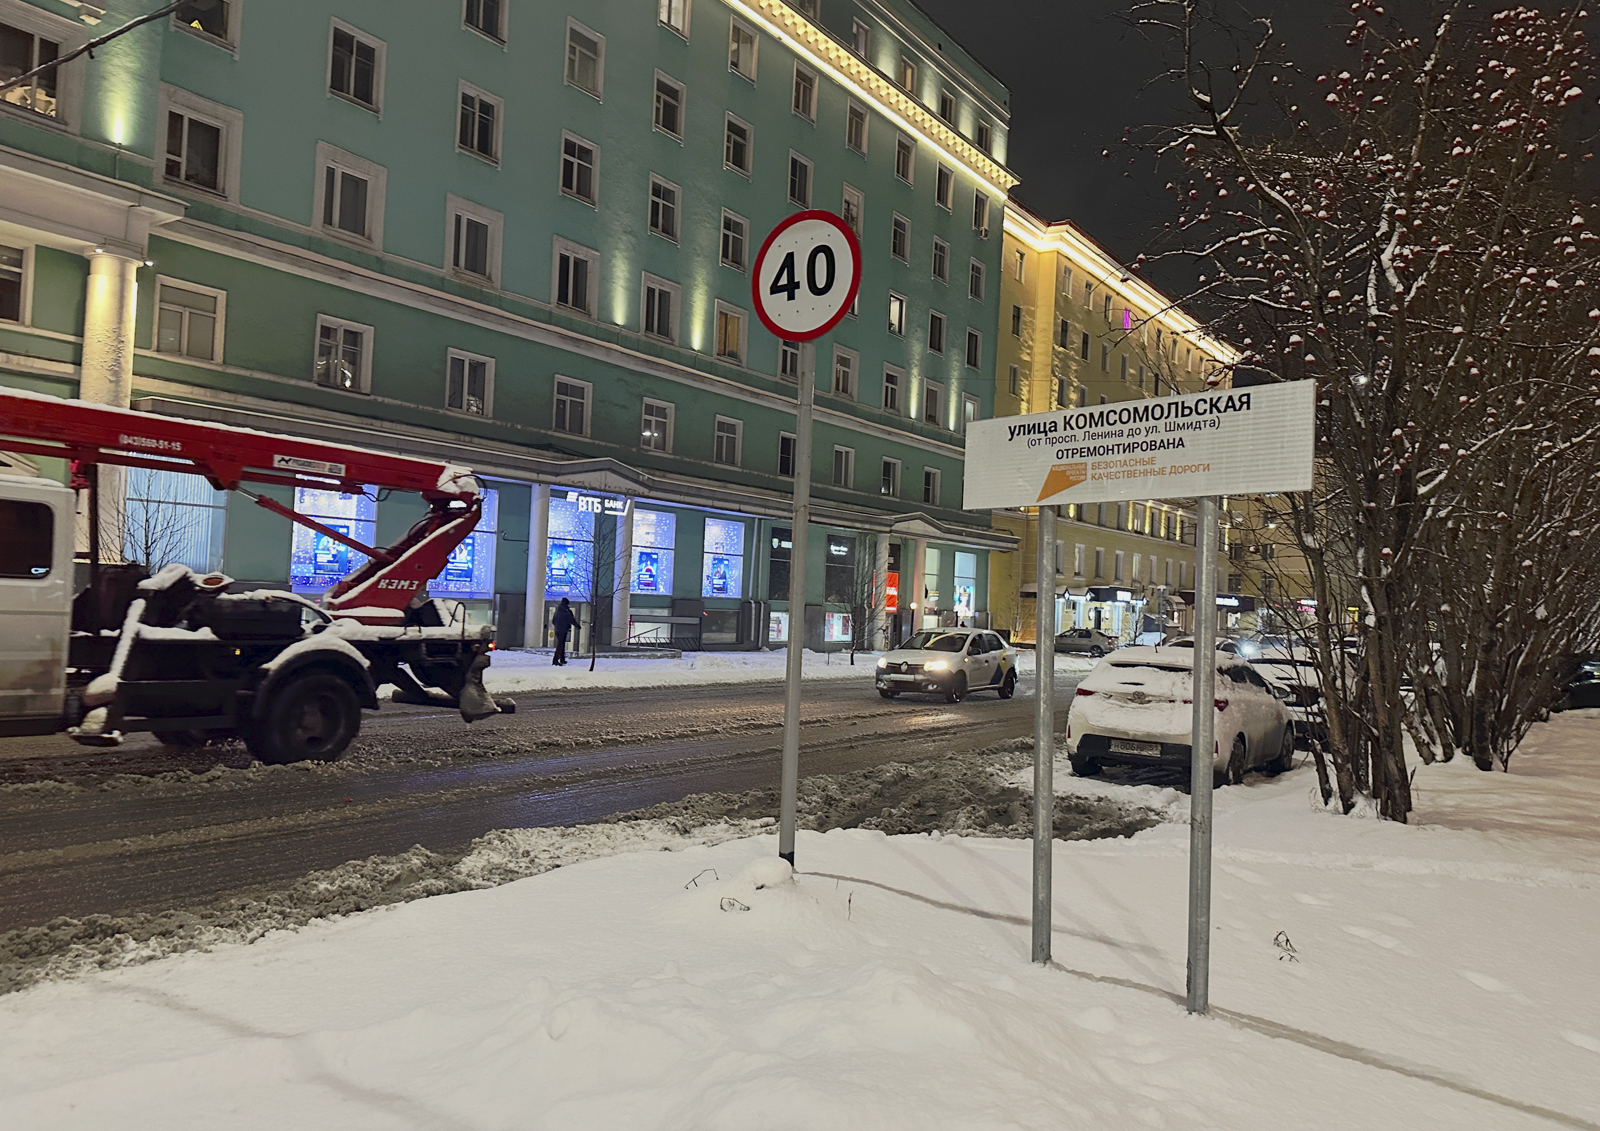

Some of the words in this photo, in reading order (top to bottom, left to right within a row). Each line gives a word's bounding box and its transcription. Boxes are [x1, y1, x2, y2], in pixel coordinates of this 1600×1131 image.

[769, 244, 836, 302] 40
[1008, 420, 1058, 441] улица
[1063, 393, 1251, 431] КОМСОМОЛЬСКАЯ
[1027, 437, 1042, 449] (от
[1045, 434, 1079, 447] просп.
[1082, 429, 1124, 442] Ленина
[1127, 427, 1142, 438] до
[1144, 425, 1160, 437] ул.
[1164, 415, 1221, 432] Шмидта)
[1056, 437, 1185, 460] ОТРЕМОНТИРОВАНА
[1091, 456, 1156, 470] БЕЗОПАСНЫЕ
[1091, 466, 1167, 481] КАЧЕСТВЕННЫЕ
[1169, 463, 1211, 476] ДОРОГИ
[578, 496, 602, 513] ВТБ
[604, 499, 624, 509] БАНК
[377, 579, 419, 590] КЭМЗ
